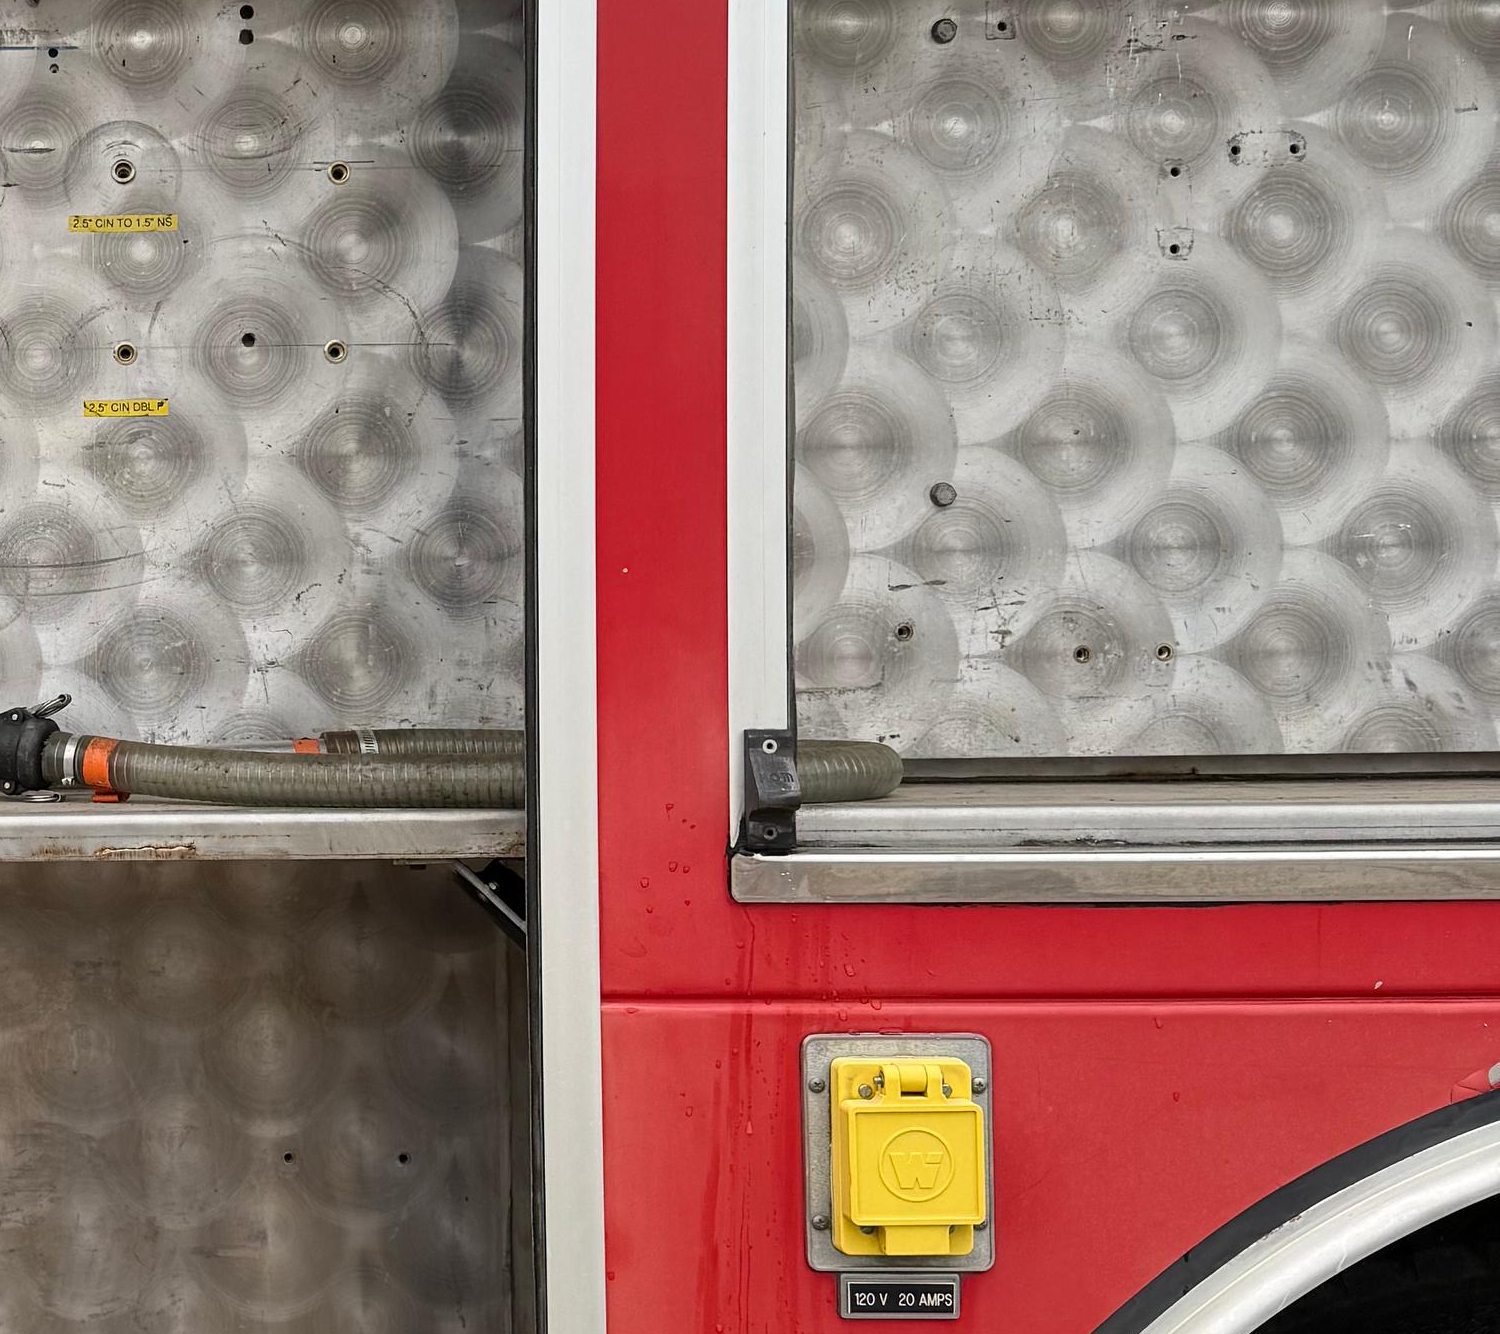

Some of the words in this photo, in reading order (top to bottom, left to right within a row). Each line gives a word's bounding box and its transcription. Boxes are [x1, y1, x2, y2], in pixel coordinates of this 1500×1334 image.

[73, 218, 92, 228] 2.5"
[95, 218, 114, 228] CIN
[117, 218, 132, 227] TO
[136, 218, 154, 227] 1.5"
[157, 217, 173, 227] NS
[111, 402, 130, 412] CIN
[133, 402, 154, 411] DBL
[855, 1293, 876, 1306] 120
[879, 1293, 888, 1306] V
[899, 1293, 915, 1306] 20
[918, 1293, 953, 1307] AMPS
